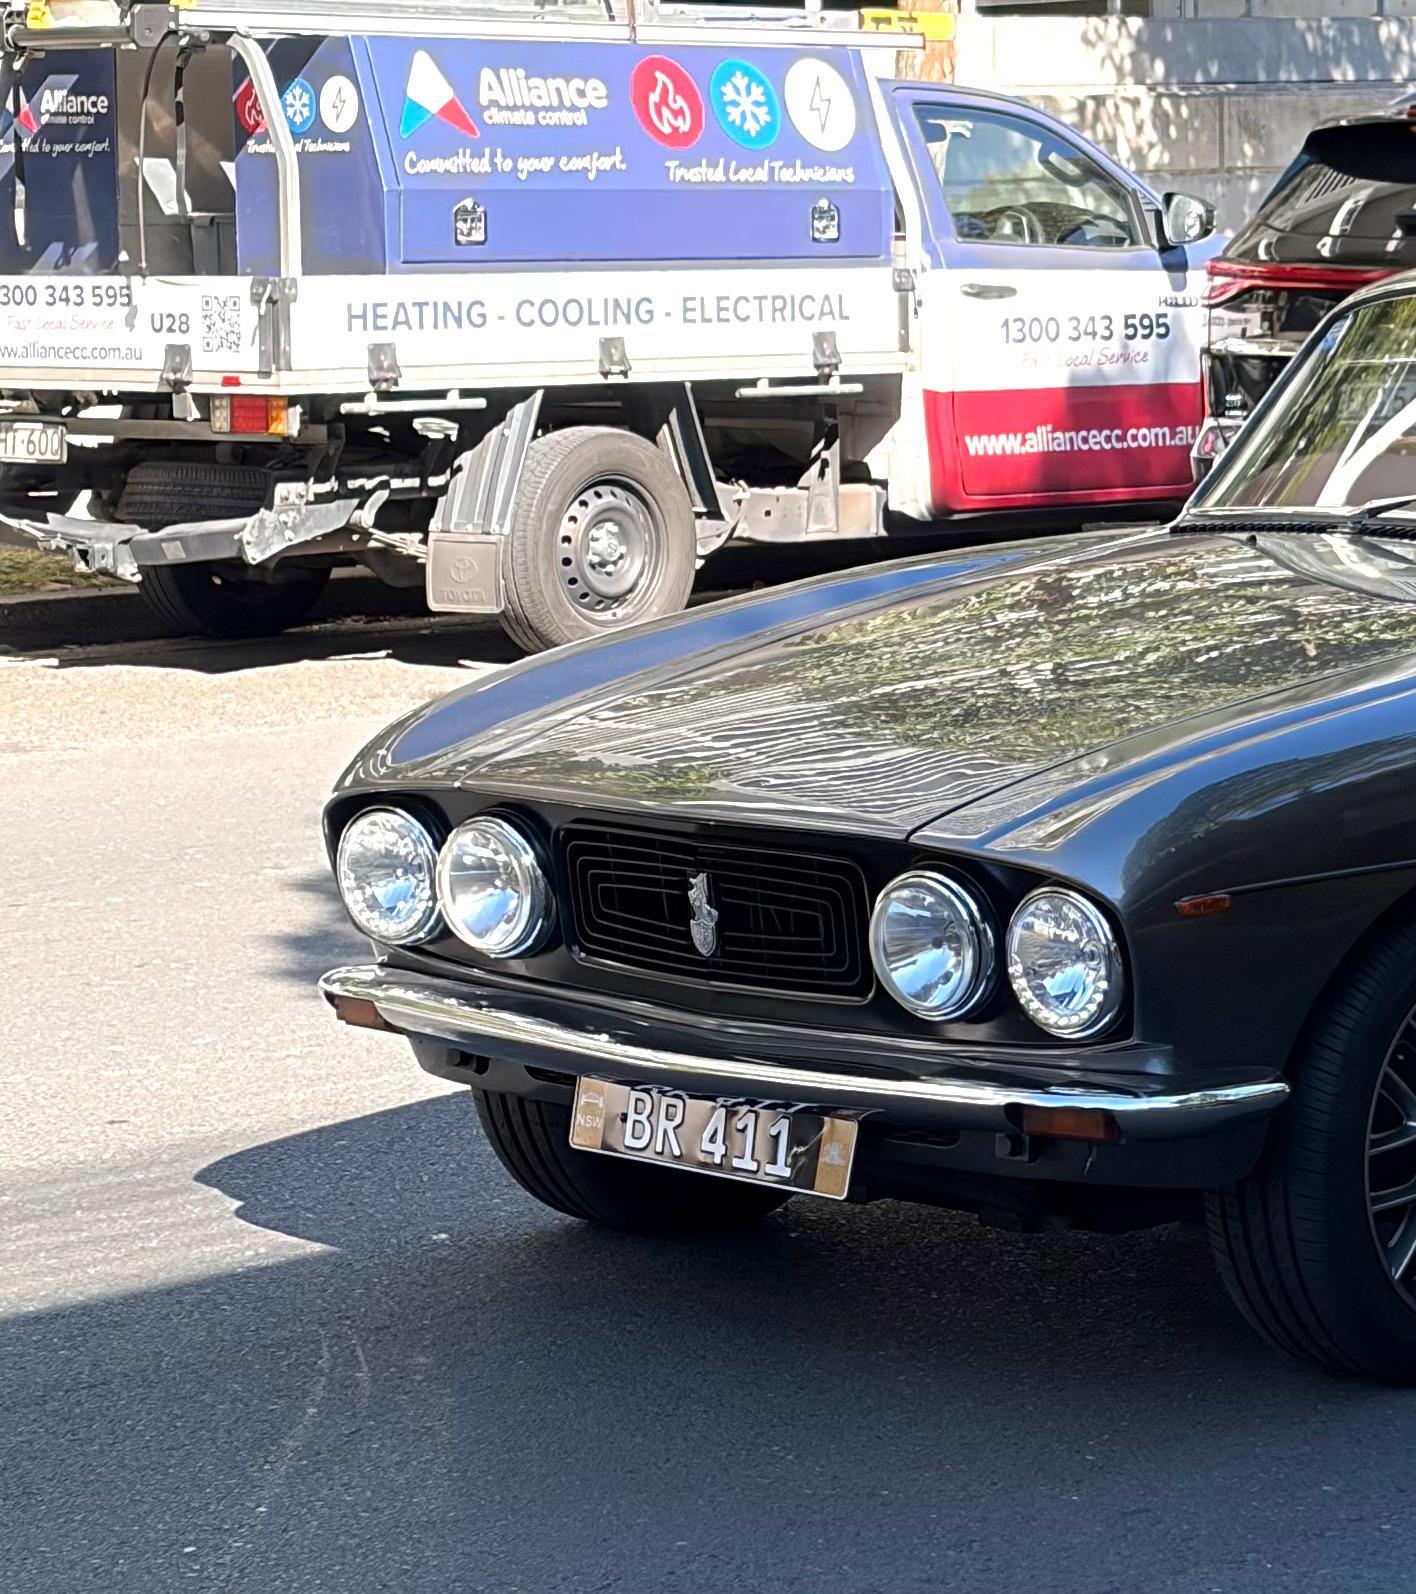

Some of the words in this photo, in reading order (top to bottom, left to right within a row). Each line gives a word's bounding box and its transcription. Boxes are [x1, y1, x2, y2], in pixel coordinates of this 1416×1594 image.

[479, 67, 608, 109] Alliance
[40, 89, 109, 113] Alliance
[483, 107, 536, 126] climate
[538, 109, 588, 126] control
[52, 142, 73, 158] your
[404, 148, 492, 175] Committed
[494, 148, 514, 172] to
[517, 156, 555, 181] your
[559, 146, 626, 181] comfort.
[665, 157, 727, 183] Trusted
[729, 158, 770, 183] Local
[770, 159, 856, 183] Technicians
[45, 285, 84, 307] 343
[91, 285, 132, 307] 595
[150, 313, 190, 334] U28
[347, 300, 488, 332] HEATING
[515, 297, 655, 327] COOLING
[682, 294, 850, 324] ELECTRICAL
[1001, 317, 1060, 344] 1300
[1068, 315, 1114, 342] 343
[1123, 313, 1171, 341] 595
[1056, 349, 1096, 369] Local
[1097, 346, 1149, 367] Service
[965, 424, 1200, 456] www.alliancecc.com.au
[440, 587, 488, 604] TOYOTA
[577, 1113, 604, 1129] NSW
[623, 1089, 687, 1158] BR
[701, 1107, 793, 1178] 411
